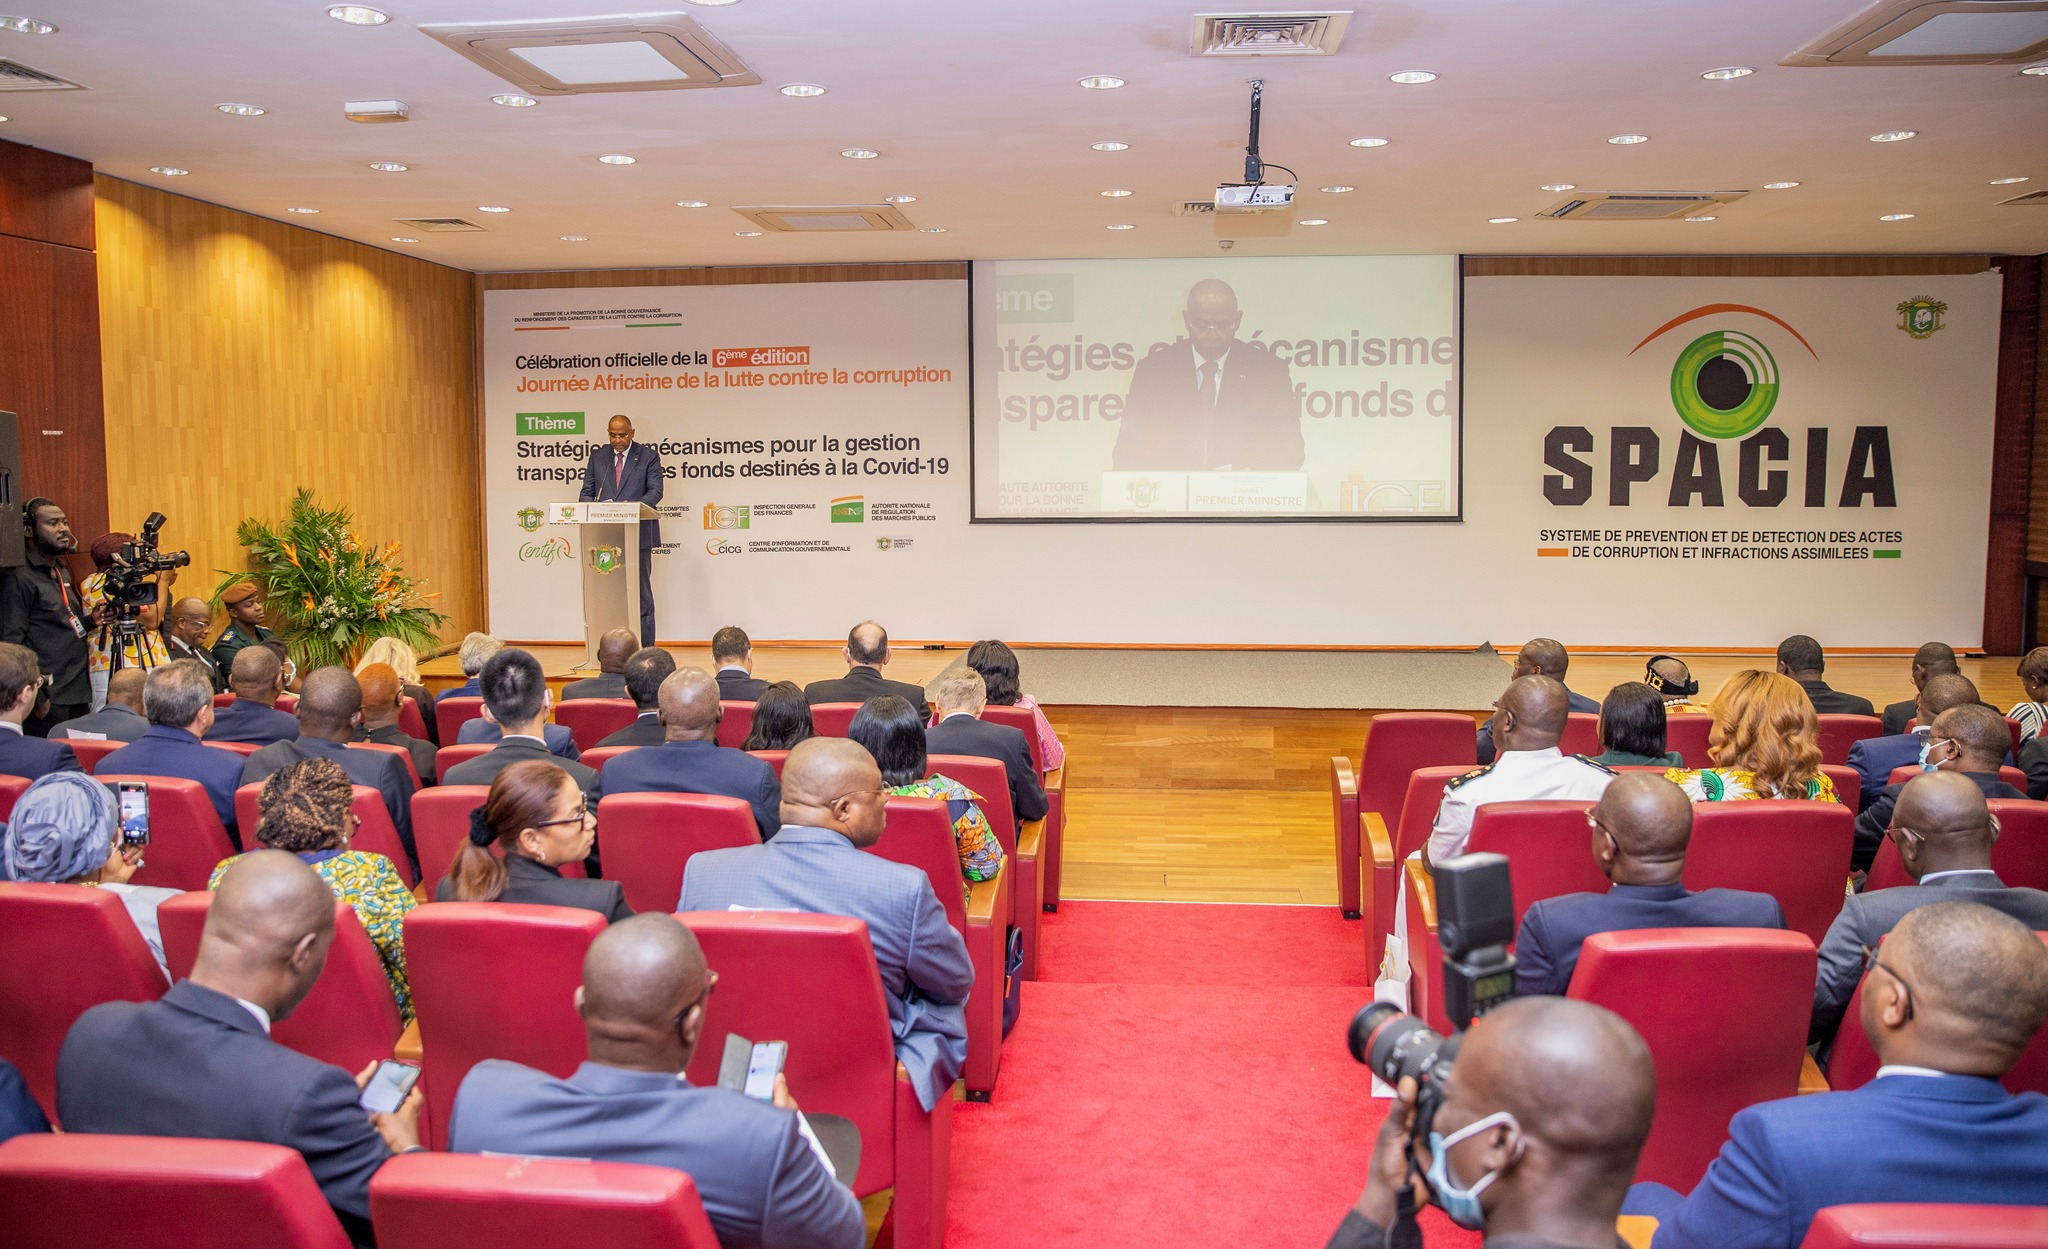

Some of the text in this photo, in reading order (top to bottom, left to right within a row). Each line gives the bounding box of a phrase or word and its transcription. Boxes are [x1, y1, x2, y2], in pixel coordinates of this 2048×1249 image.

[515, 349, 808, 369] Célébration officielle de la 6ème édition
[516, 366, 952, 393] Journée Africaine de la lutte contre la corruption
[525, 416, 576, 430] Thème
[770, 437, 817, 457] pour
[823, 435, 839, 452] la
[845, 433, 920, 456] gestion
[682, 461, 734, 478] fonds
[740, 459, 820, 478] destinés
[825, 459, 836, 476] à
[842, 458, 858, 475] la
[863, 457, 949, 475] Covid-19
[1542, 426, 1897, 508] SPACIA
[1032, 482, 1088, 492] AUTORITE
[1026, 495, 1040, 505] LA
[1043, 494, 1084, 504] BONNE
[1195, 496, 1302, 505] PREMIER MINISTRE
[708, 506, 748, 529] IGF
[1540, 529, 1903, 543] SYSTEME DE PREVENTION ET DE DETECTION DES ACTES
[1572, 546, 1869, 559] DE CORRUPTION ET INFRACTIONS ASSIMILEES
